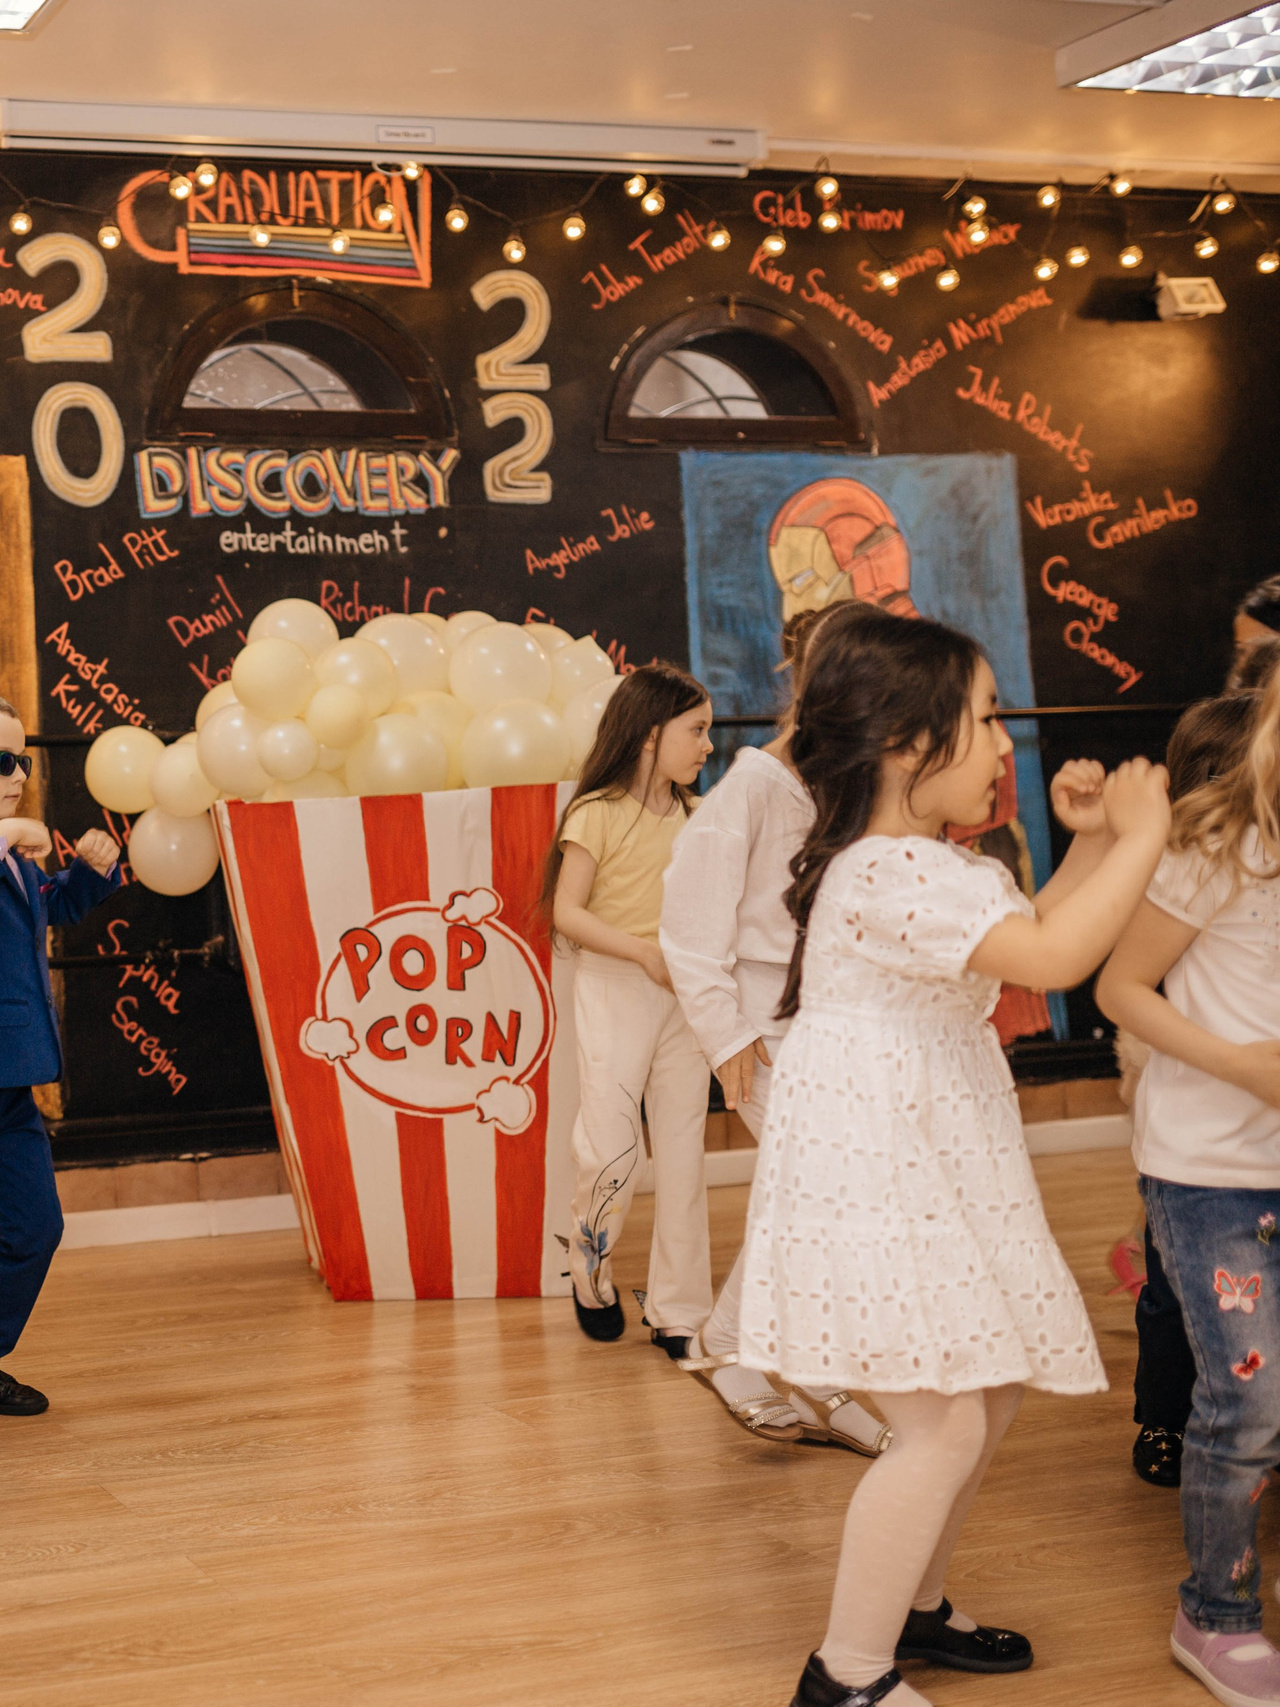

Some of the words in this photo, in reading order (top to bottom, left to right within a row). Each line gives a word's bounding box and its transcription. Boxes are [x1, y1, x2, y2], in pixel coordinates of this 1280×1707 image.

[117, 167, 432, 288] GRADUATION
[753, 190, 812, 230] Gleb
[581, 263, 644, 310] John
[748, 245, 796, 294] Kira
[800, 267, 894, 355] Smirnova
[867, 338, 948, 409] Anastasia
[956, 364, 1012, 421] Julia
[1015, 391, 1095, 473] Roberts
[135, 446, 461, 519] DISCOVERY
[1025, 479, 1119, 530] Veronika
[53, 541, 126, 602] Brad
[122, 525, 181, 570] Pitt
[220, 521, 409, 555] entertainment
[524, 536, 601, 579] Angelina
[600, 504, 655, 542] Jolie
[166, 573, 244, 649] Daniil
[1040, 555, 1119, 632] George
[44, 620, 148, 727] Anastasia
[97, 919, 182, 1014] Sphia
[339, 924, 487, 1003] POP
[365, 1003, 522, 1068] CORN
